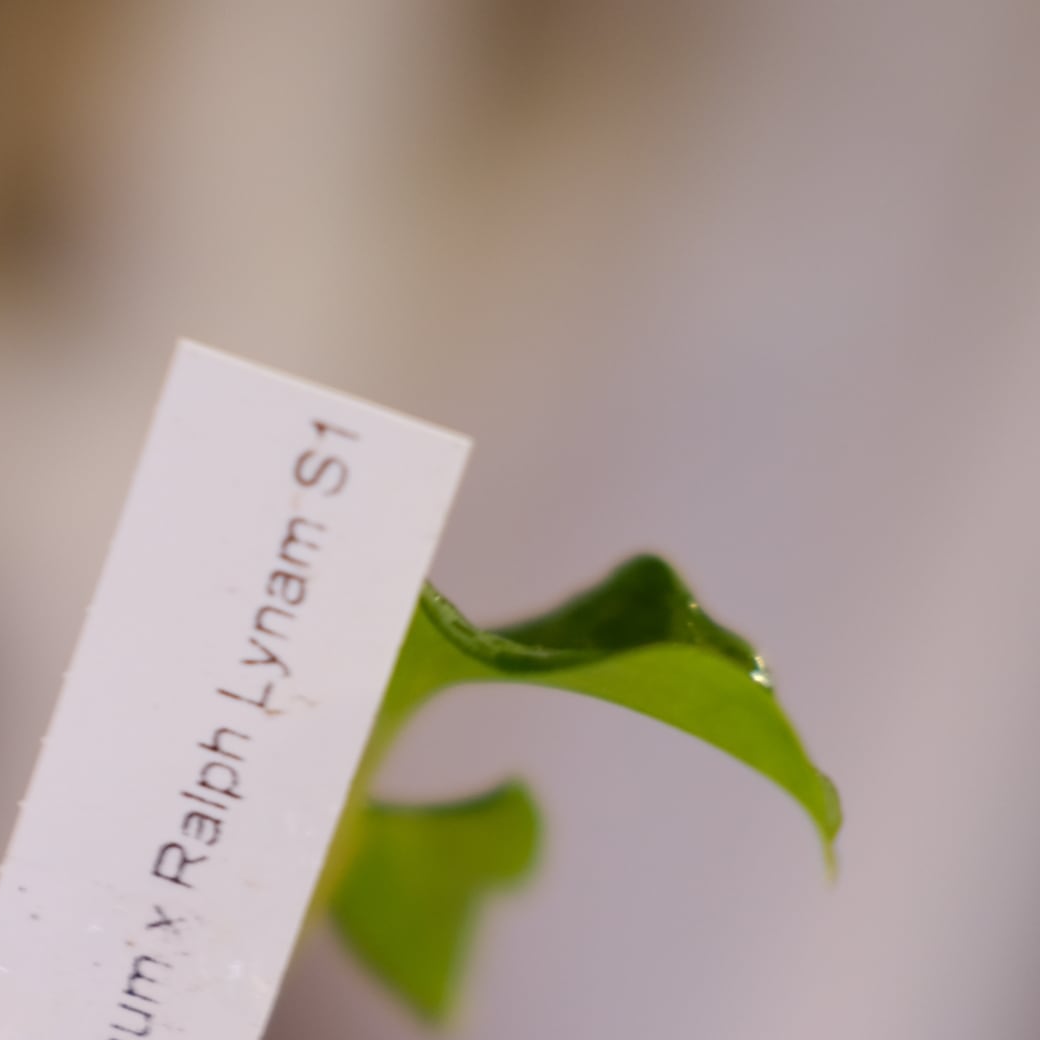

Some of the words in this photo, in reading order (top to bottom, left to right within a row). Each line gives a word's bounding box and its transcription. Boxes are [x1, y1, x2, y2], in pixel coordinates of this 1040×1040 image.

[150, 726, 255, 888] Ralph
[217, 515, 327, 709] Lynam
[294, 418, 361, 497] S1
